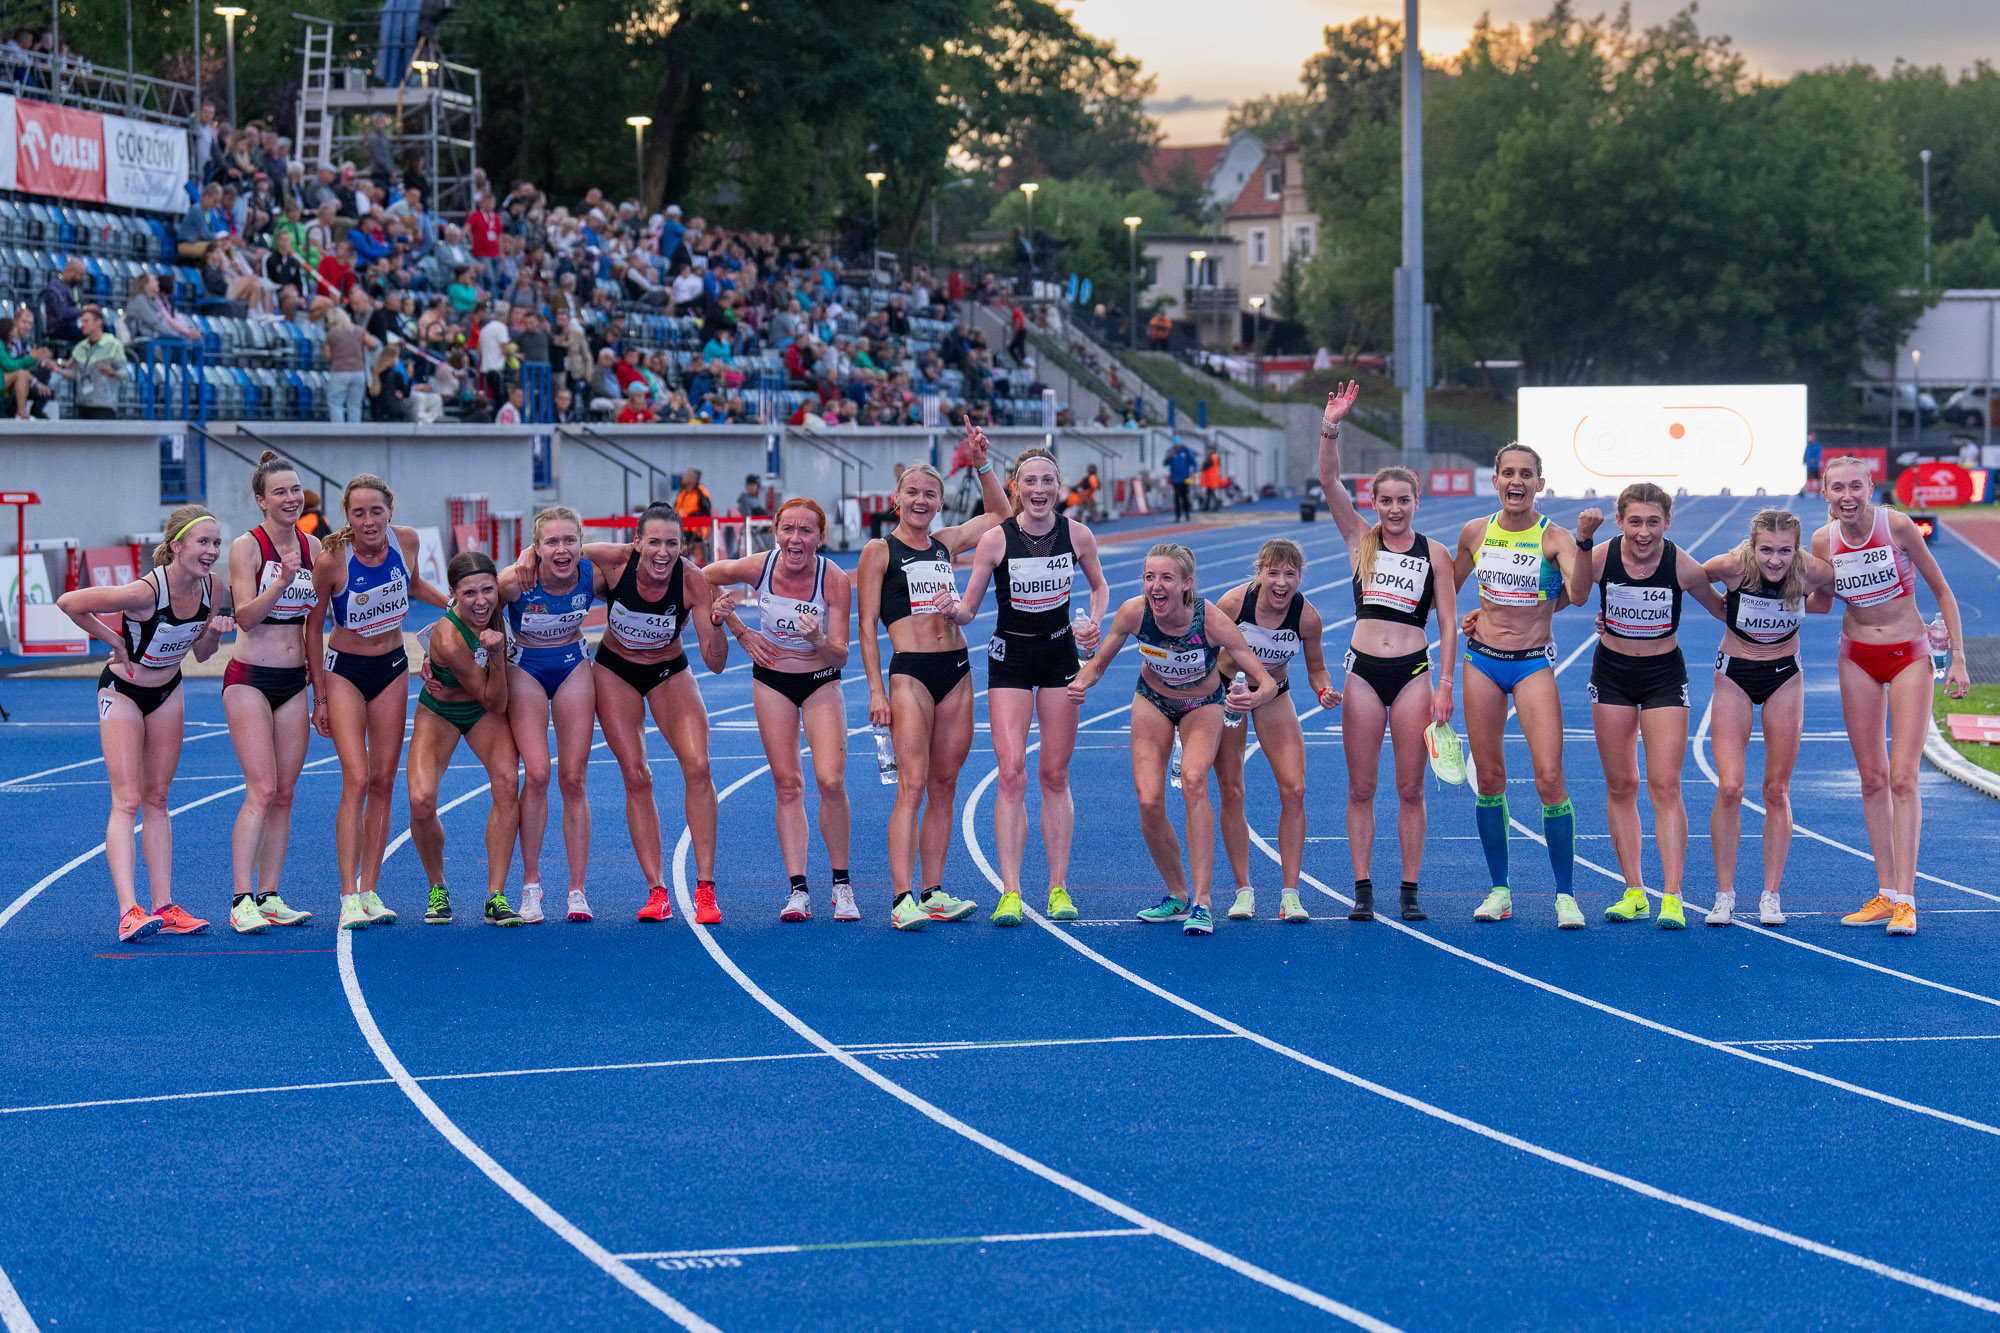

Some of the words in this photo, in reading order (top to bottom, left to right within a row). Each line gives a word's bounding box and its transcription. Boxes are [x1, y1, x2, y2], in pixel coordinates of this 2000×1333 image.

[50, 132, 100, 172] ORLEN
[1046, 556, 1069, 571] 442
[1512, 553, 1536, 567] 397
[1862, 549, 1888, 565] 288
[934, 563, 952, 574] 492
[1400, 558, 1423, 573] 611
[1012, 576, 1071, 594] DUBIELLA
[1369, 571, 1414, 593] TOPKA
[1477, 568, 1537, 588] KORYTKOWSKA
[1835, 567, 1897, 592] BUDZIŁEK
[382, 580, 403, 597] 548
[1642, 590, 1667, 602] 164
[1741, 597, 1771, 607] GORZÓW
[349, 596, 407, 623] RASIŃSKA
[794, 603, 818, 616] 486
[1607, 603, 1670, 620] KAROLCZUK
[559, 612, 583, 624] 423
[646, 616, 670, 628] 616
[1744, 617, 1797, 629] MISJAN
[611, 618, 671, 640] KACZYŃSKA
[1051, 627, 1067, 641] NIKE
[1271, 632, 1296, 643] 440
[1144, 648, 1163, 658] DHL
[1174, 652, 1199, 663] 499
[1478, 646, 1515, 659] AdRunLine
[813, 667, 834, 680] NIKE
[1543, 803, 1571, 815] Ferrys
